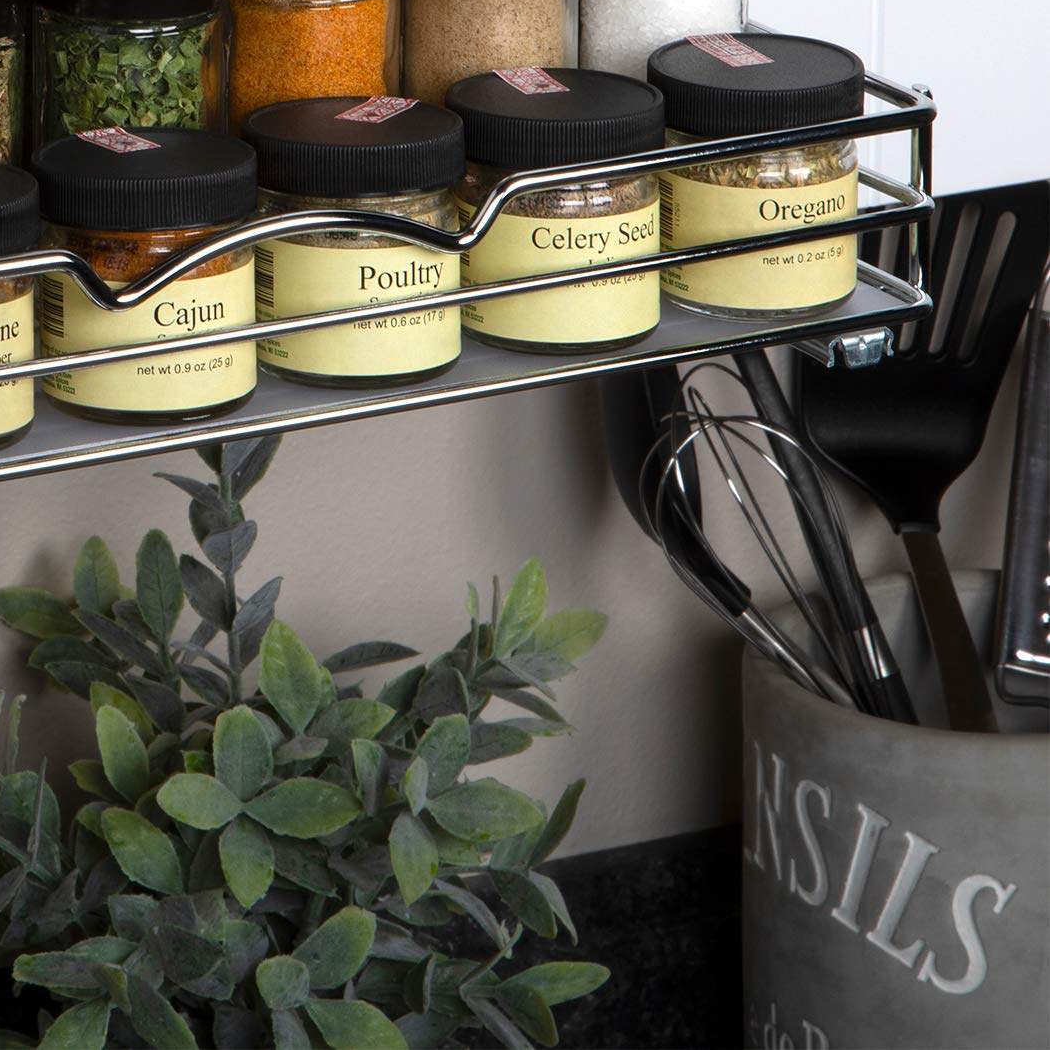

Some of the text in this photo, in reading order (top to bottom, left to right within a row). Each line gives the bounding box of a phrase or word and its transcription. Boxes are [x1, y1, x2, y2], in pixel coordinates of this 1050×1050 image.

[759, 193, 846, 224] Oregano
[531, 226, 611, 254] Celery
[618, 213, 655, 245] Seed
[762, 255, 780, 265] net
[782, 254, 795, 264] wt
[814, 251, 826, 261] oz
[358, 261, 444, 291] Poultry
[153, 299, 225, 332] Cajun
[374, 318, 388, 329] wt
[390, 316, 407, 328] 0.6
[409, 316, 422, 326] oz
[423, 310, 437, 326] (17
[136, 365, 155, 375] net
[157, 364, 171, 374] wt
[173, 362, 191, 374] 0.9
[193, 362, 206, 372] oz
[208, 357, 223, 371] (25
